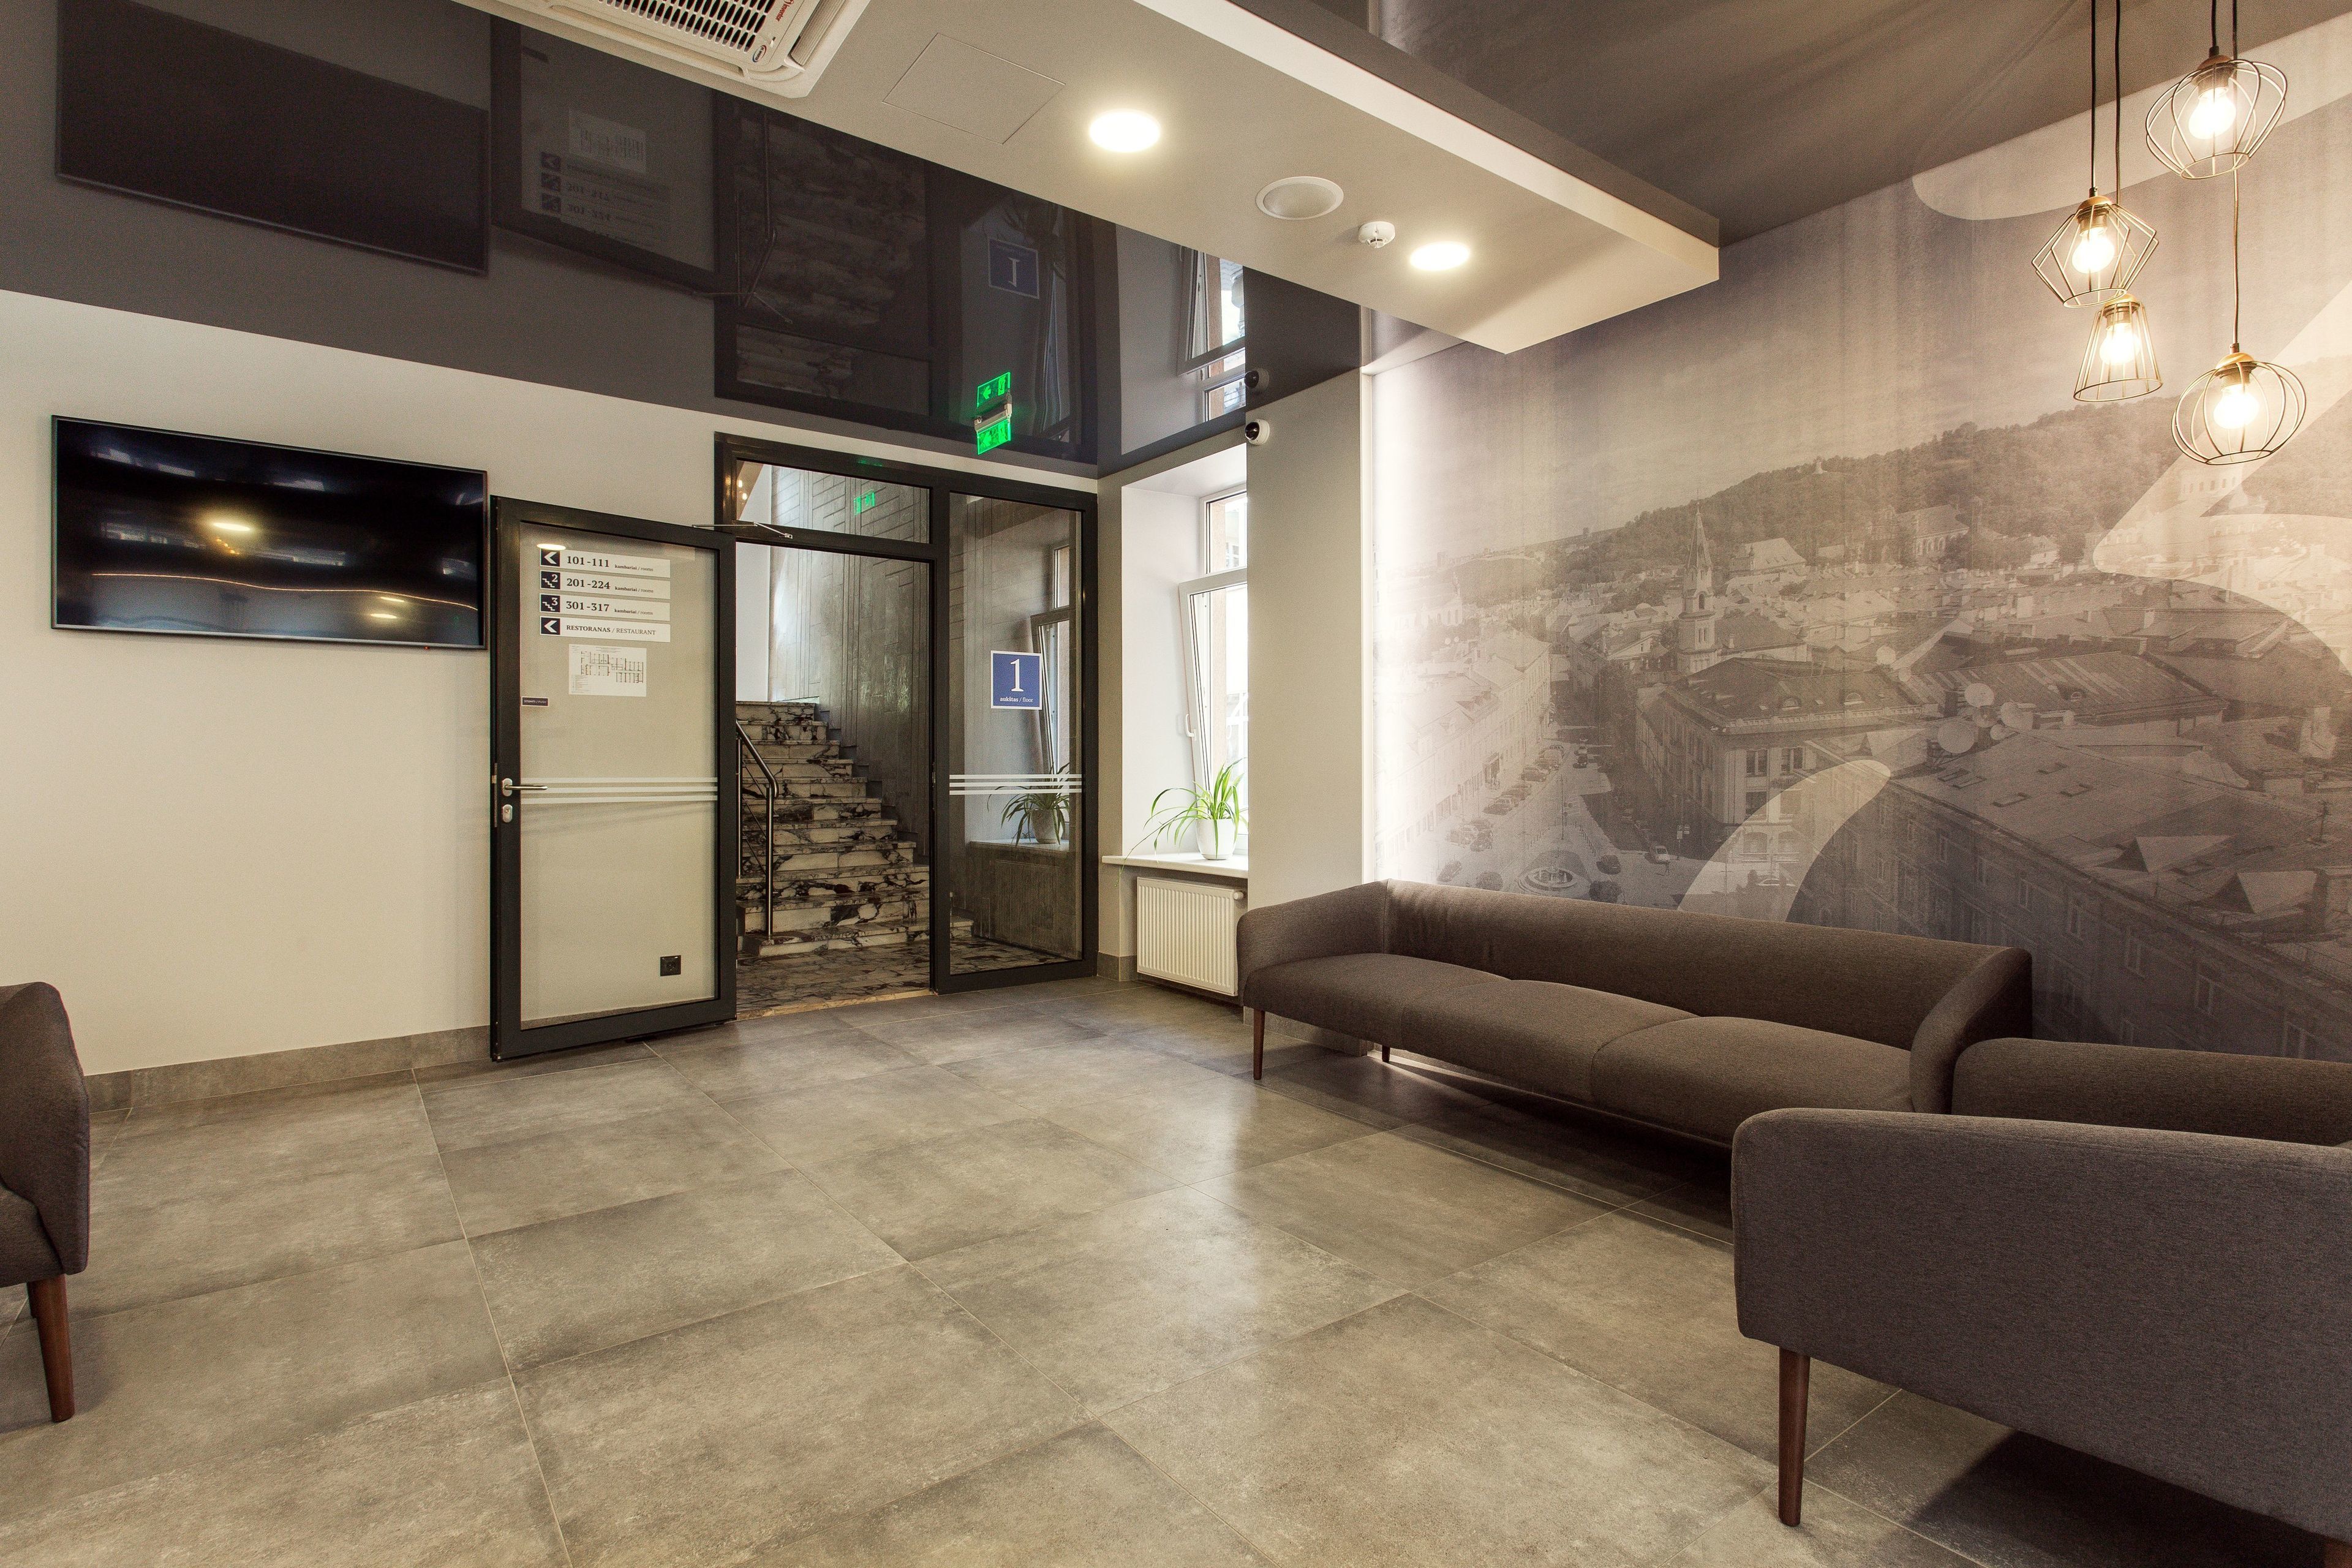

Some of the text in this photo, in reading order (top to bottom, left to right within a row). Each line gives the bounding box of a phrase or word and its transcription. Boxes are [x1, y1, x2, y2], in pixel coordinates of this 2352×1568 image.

[552, 574, 558, 582] 2
[552, 597, 558, 606] 3
[1010, 658, 1024, 692] 1
